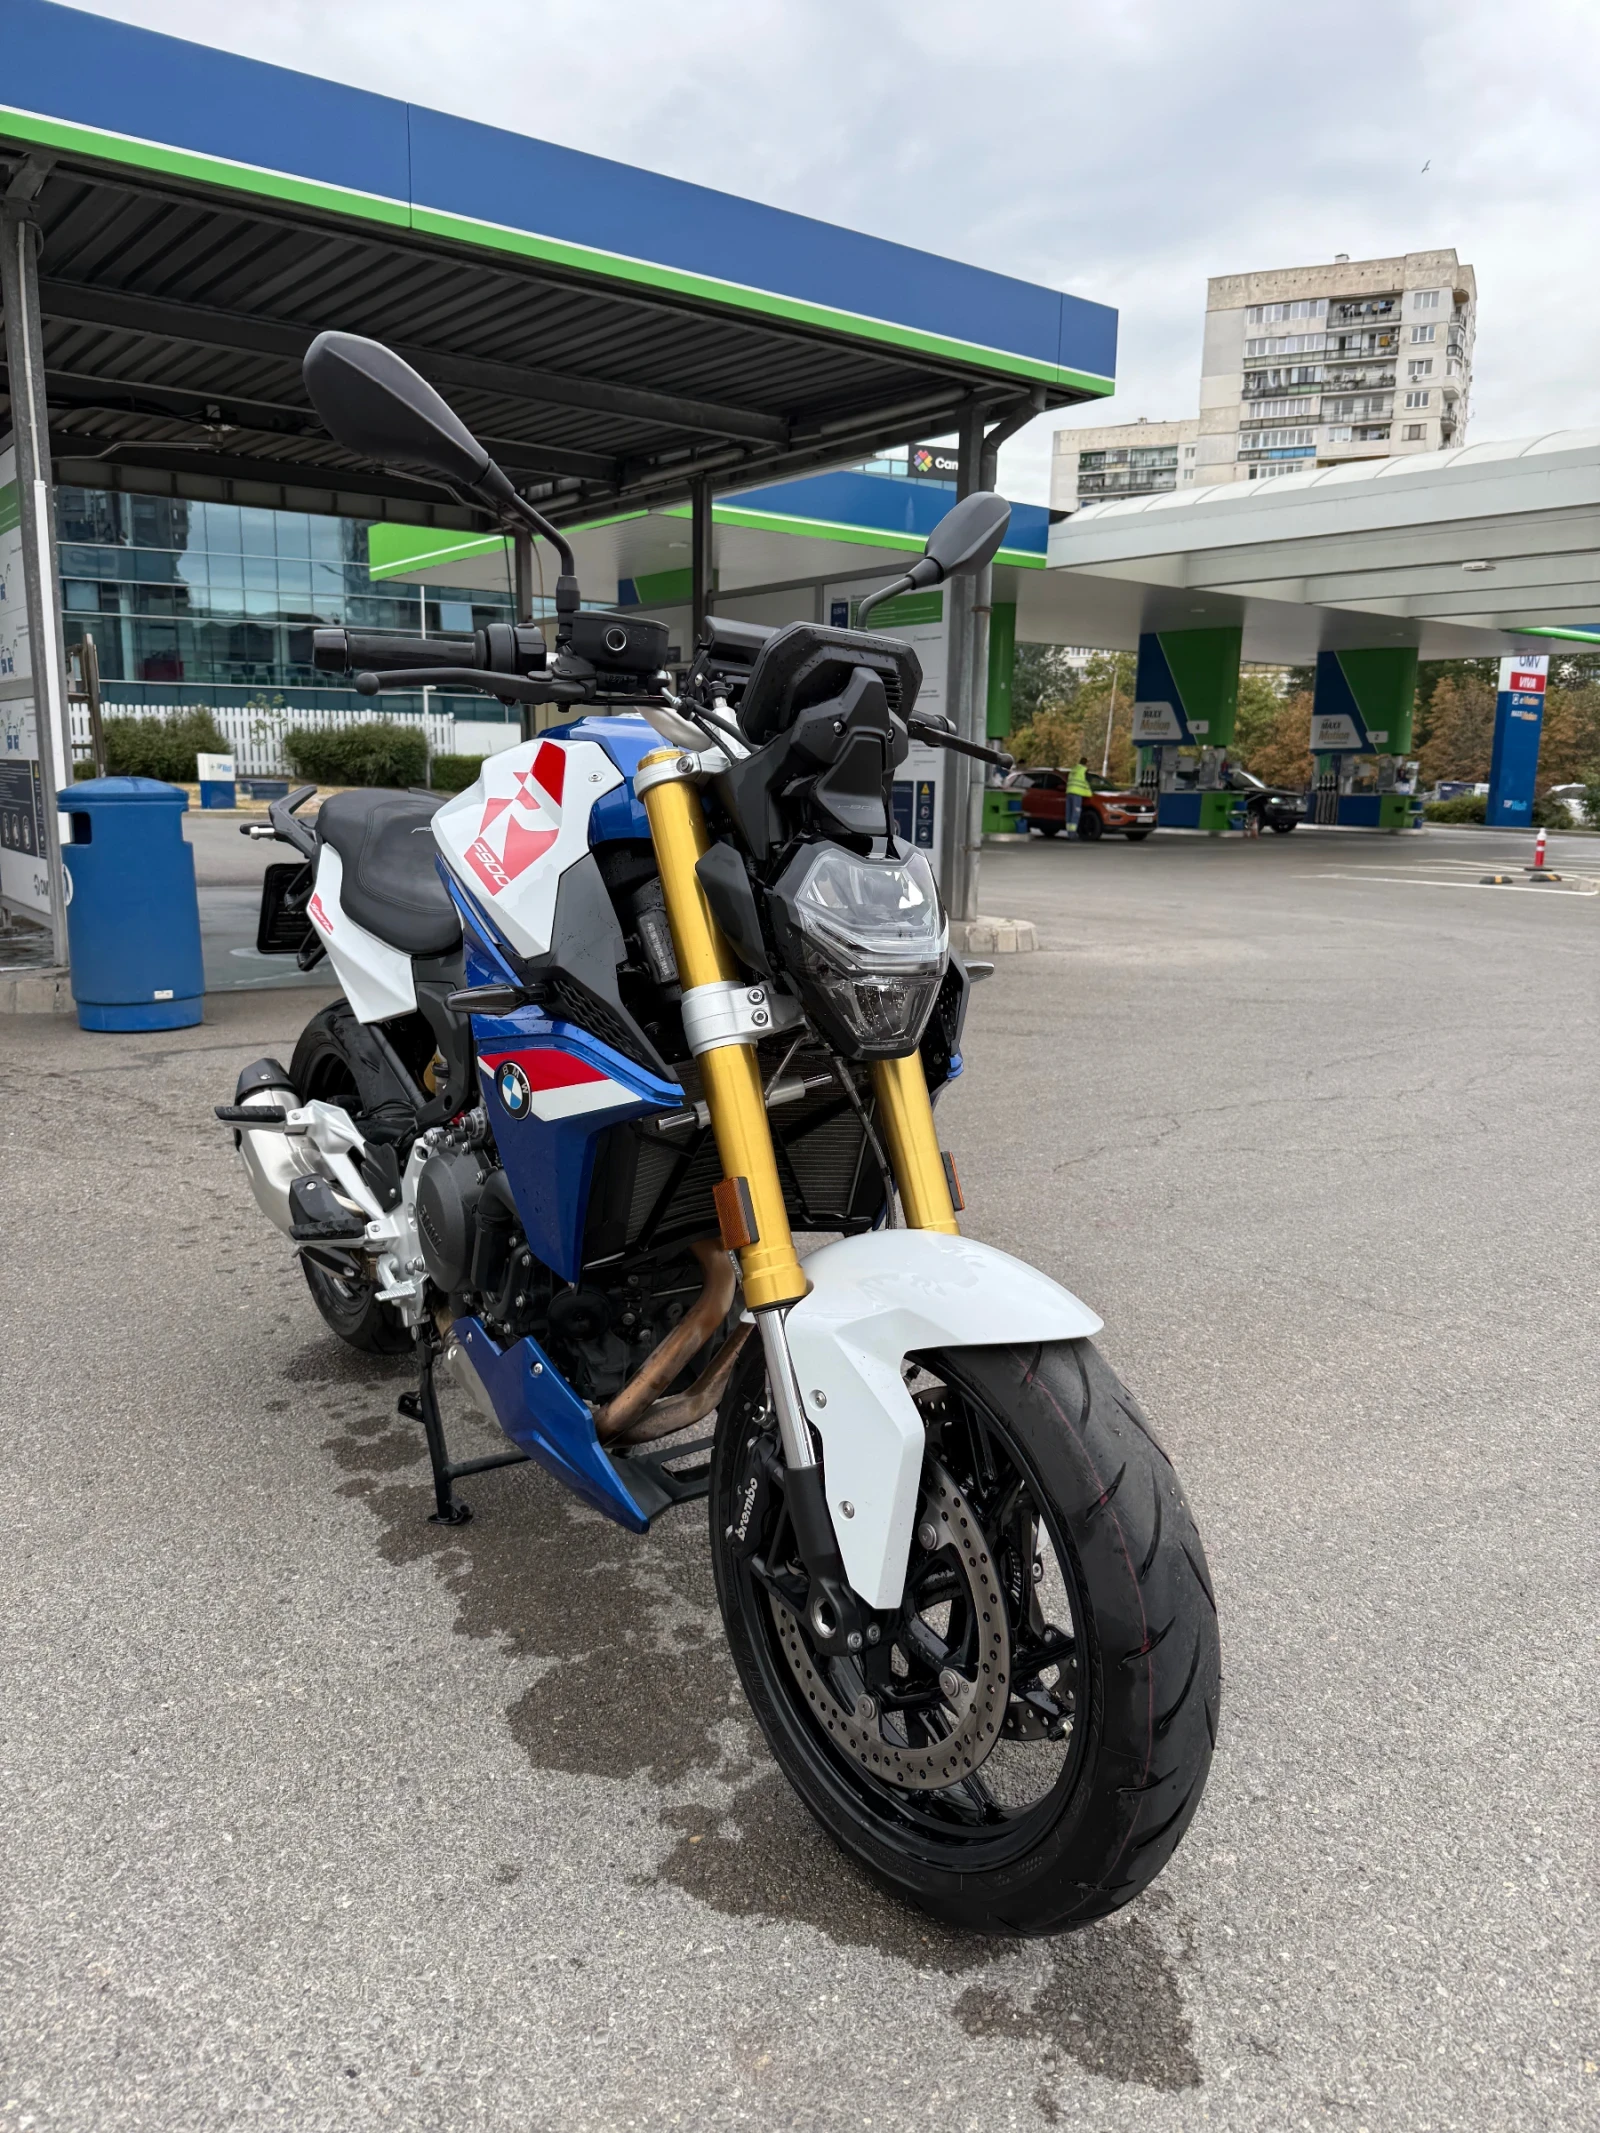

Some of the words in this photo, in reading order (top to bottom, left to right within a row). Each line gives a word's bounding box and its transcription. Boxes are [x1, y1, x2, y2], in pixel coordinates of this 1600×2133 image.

[1518, 676, 1537, 690] VIVA
[1142, 710, 1163, 719] MAXX
[1140, 719, 1171, 731] Motion
[1195, 723, 1200, 731] 4
[1320, 721, 1342, 730] MAXX
[1318, 730, 1351, 740] Motion
[472, 842, 511, 888] F900
[502, 1065, 529, 1094] BMW
[734, 1477, 758, 1542] brembo
